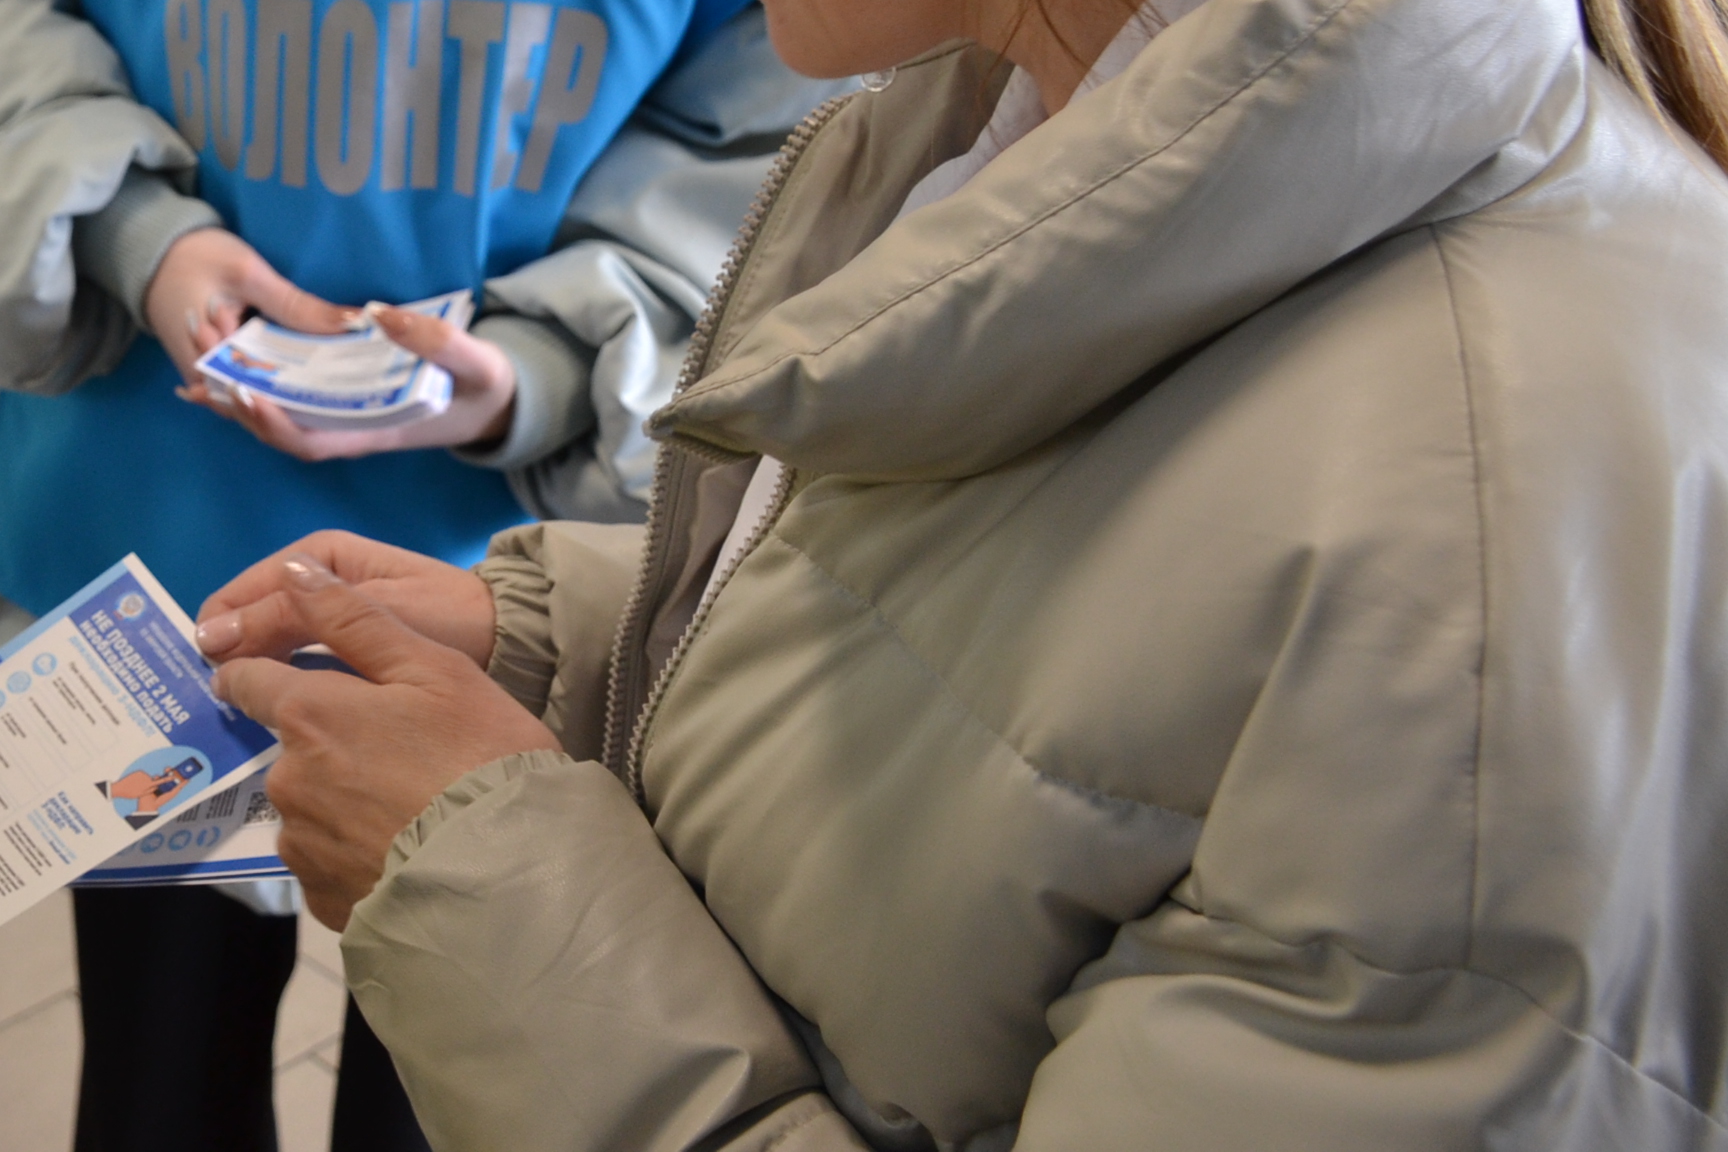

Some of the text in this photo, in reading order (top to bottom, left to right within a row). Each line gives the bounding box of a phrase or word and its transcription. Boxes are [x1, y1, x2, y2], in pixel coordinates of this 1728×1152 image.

[74, 618, 176, 735] необходимо подать
[90, 609, 190, 726] НЕ ПОЗДНЕЕ 2 МАЯ
